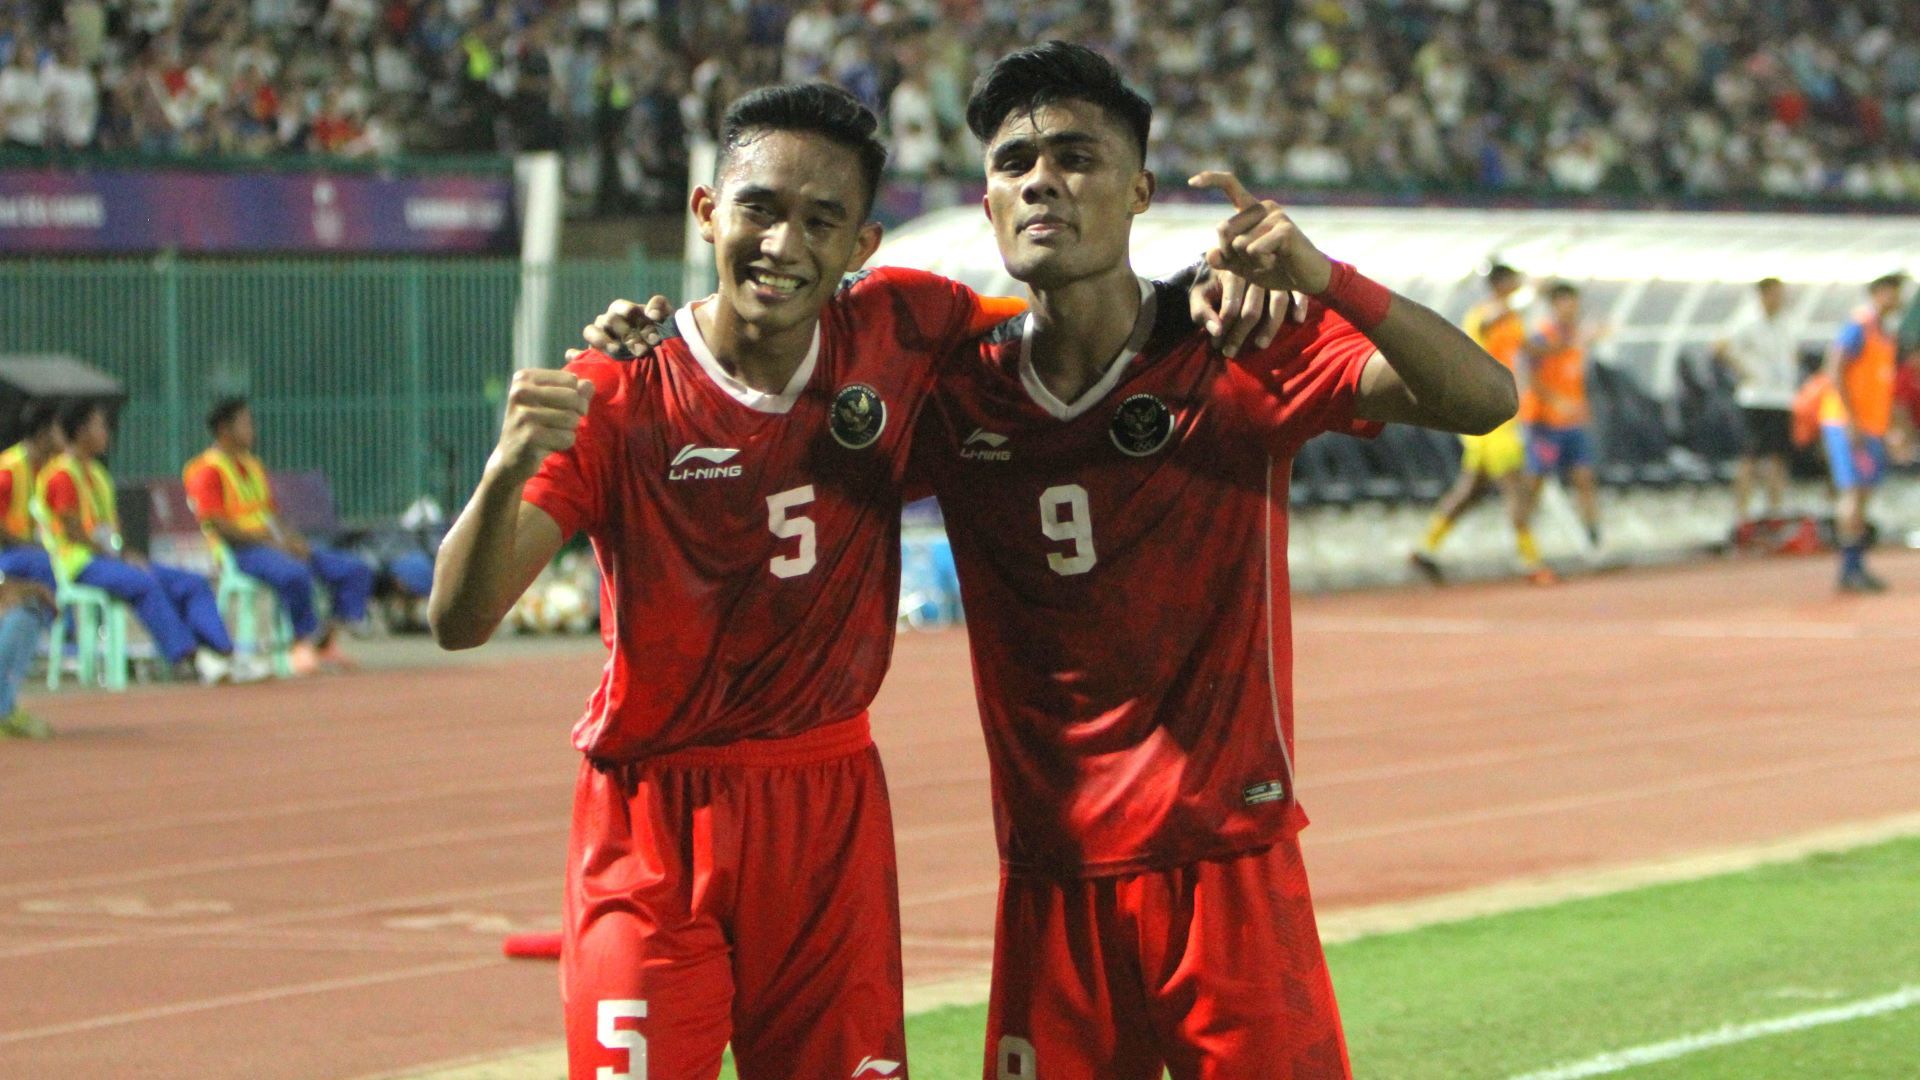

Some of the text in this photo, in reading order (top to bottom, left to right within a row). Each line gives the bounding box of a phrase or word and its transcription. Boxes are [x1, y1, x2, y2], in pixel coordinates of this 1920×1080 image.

[669, 465, 743, 481] LI-NING
[960, 448, 1012, 461] LI-NING
[766, 484, 817, 579] 5
[1039, 484, 1097, 576] 9
[596, 1000, 648, 1080] 5
